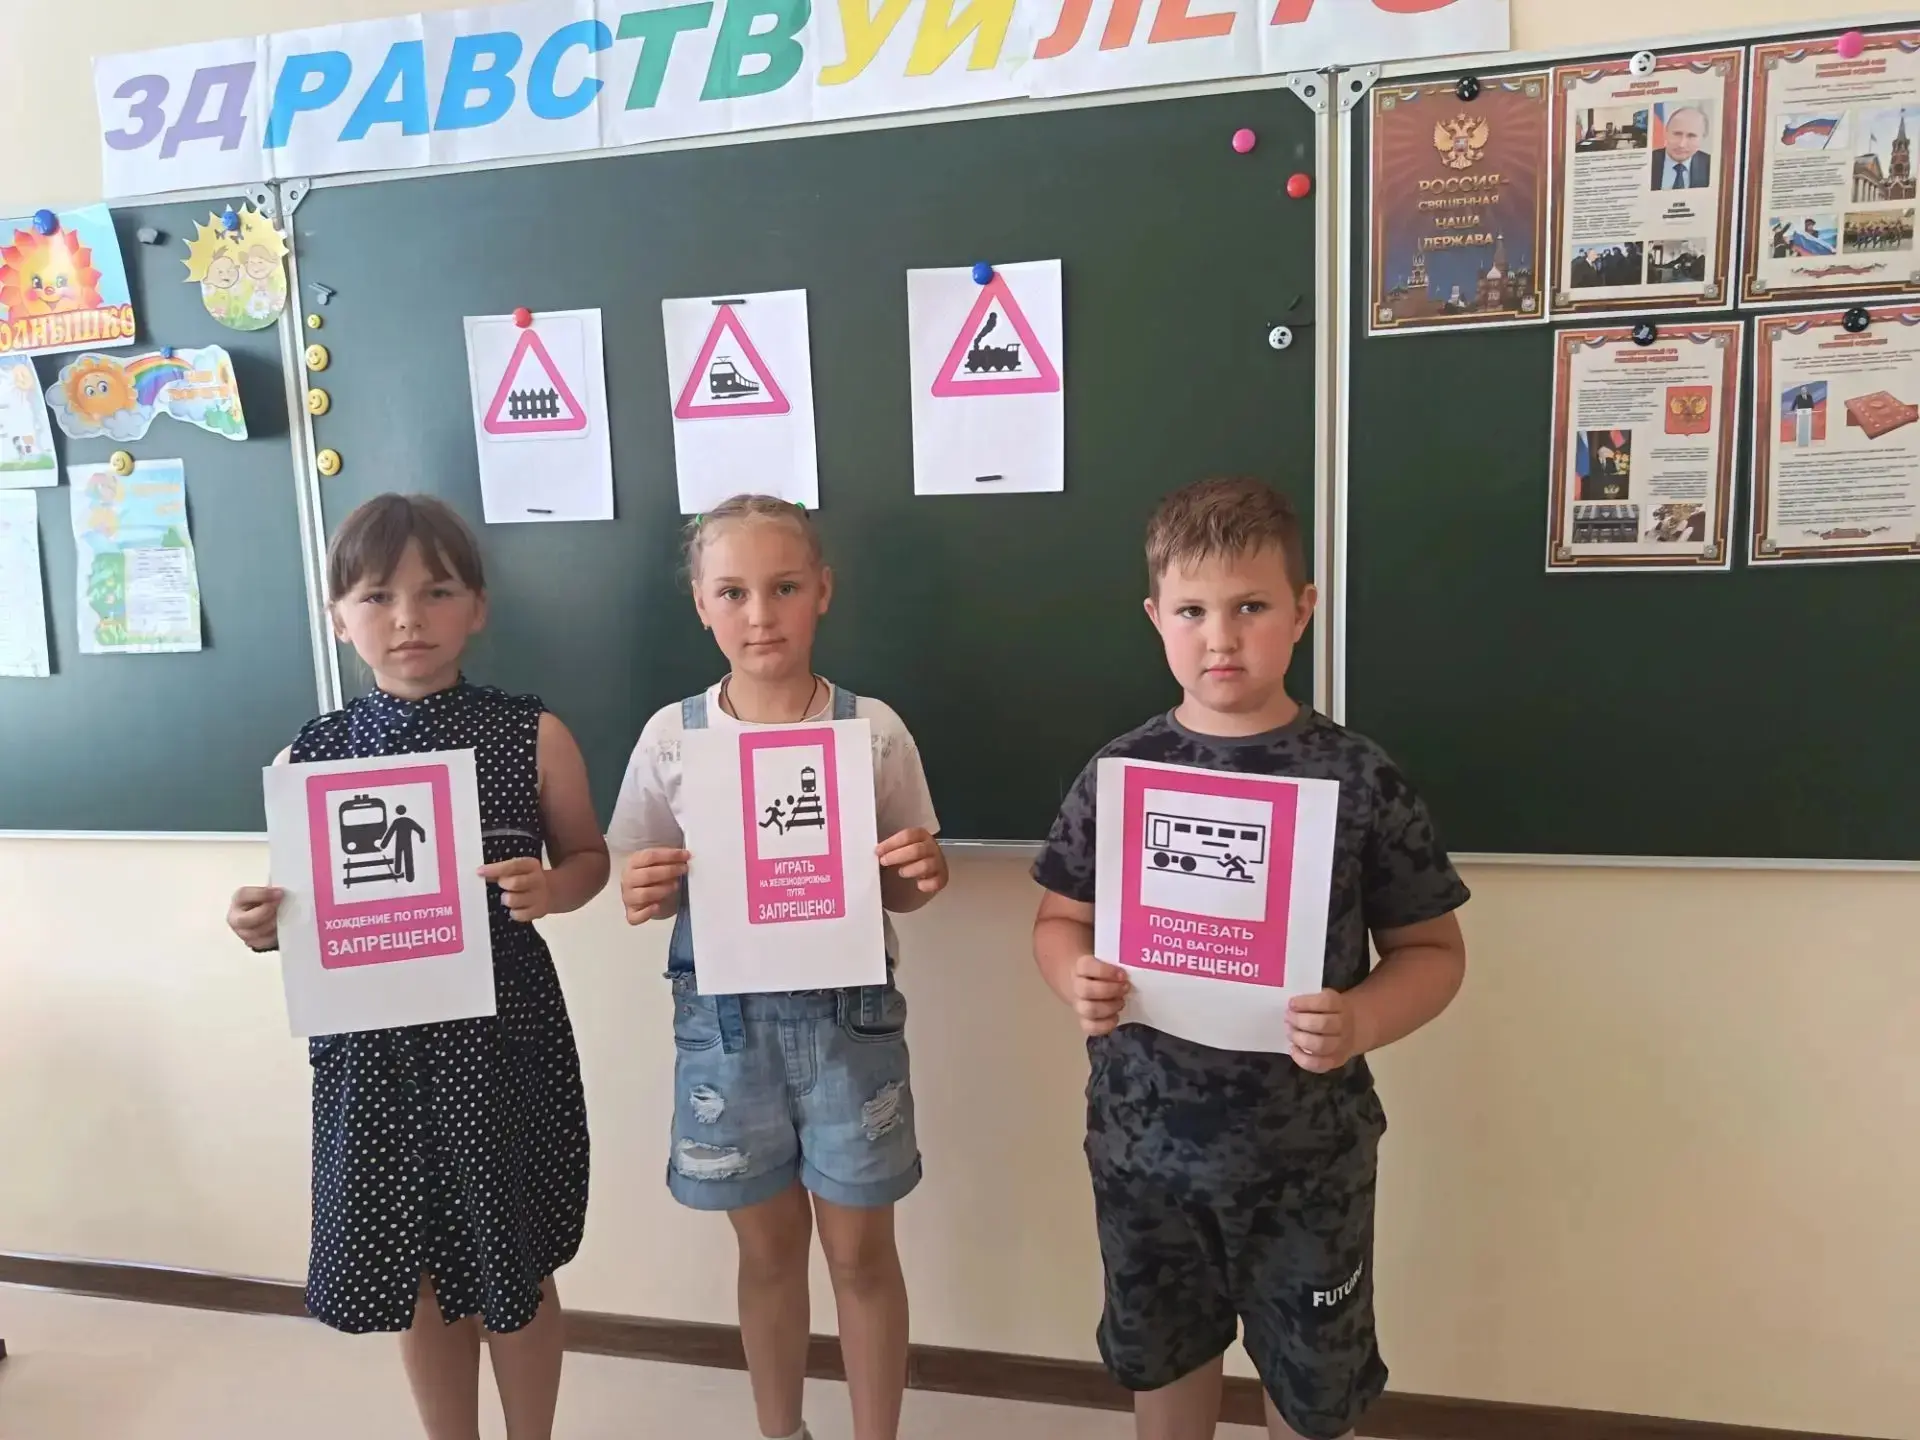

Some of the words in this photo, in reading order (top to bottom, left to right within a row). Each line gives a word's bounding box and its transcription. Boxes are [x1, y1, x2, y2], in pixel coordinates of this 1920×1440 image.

[104, 0, 1016, 159] ЗДРАВСТВУЙ
[1419, 174, 1500, 194] РОССИЯ
[774, 860, 815, 875] ИГРАТЬ
[759, 879, 769, 888] НА
[325, 912, 391, 931] ХОЖДЕНИЕ
[394, 910, 412, 923] ПО
[414, 905, 453, 920] ПУТЯМ
[758, 898, 836, 920] ЗАПРЕЩЕНО!
[1149, 914, 1255, 941] ПОДЛЕЗАТЬ
[327, 925, 457, 957] ЗАПРЕЩЕНО!
[1153, 933, 1182, 949] ПОД
[1186, 941, 1248, 957] ВАГОНЫ
[1140, 947, 1260, 978] ЗАПРЕЩЕНО!
